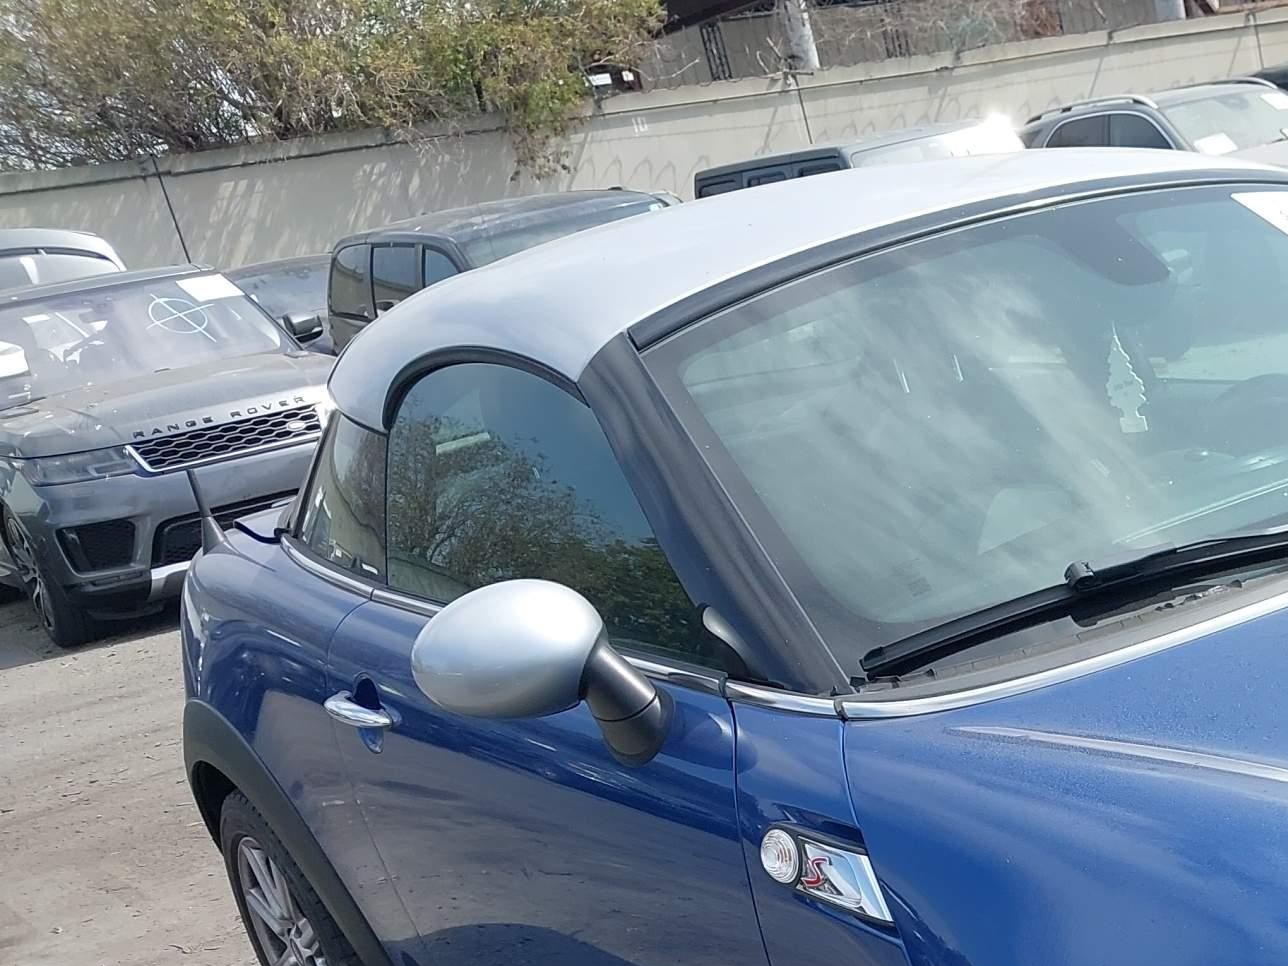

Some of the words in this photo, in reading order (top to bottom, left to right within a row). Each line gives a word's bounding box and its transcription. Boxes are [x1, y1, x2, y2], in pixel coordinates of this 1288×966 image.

[132, 416, 214, 439] RANGE
[230, 396, 305, 418] ROVER
[802, 856, 832, 889] S
